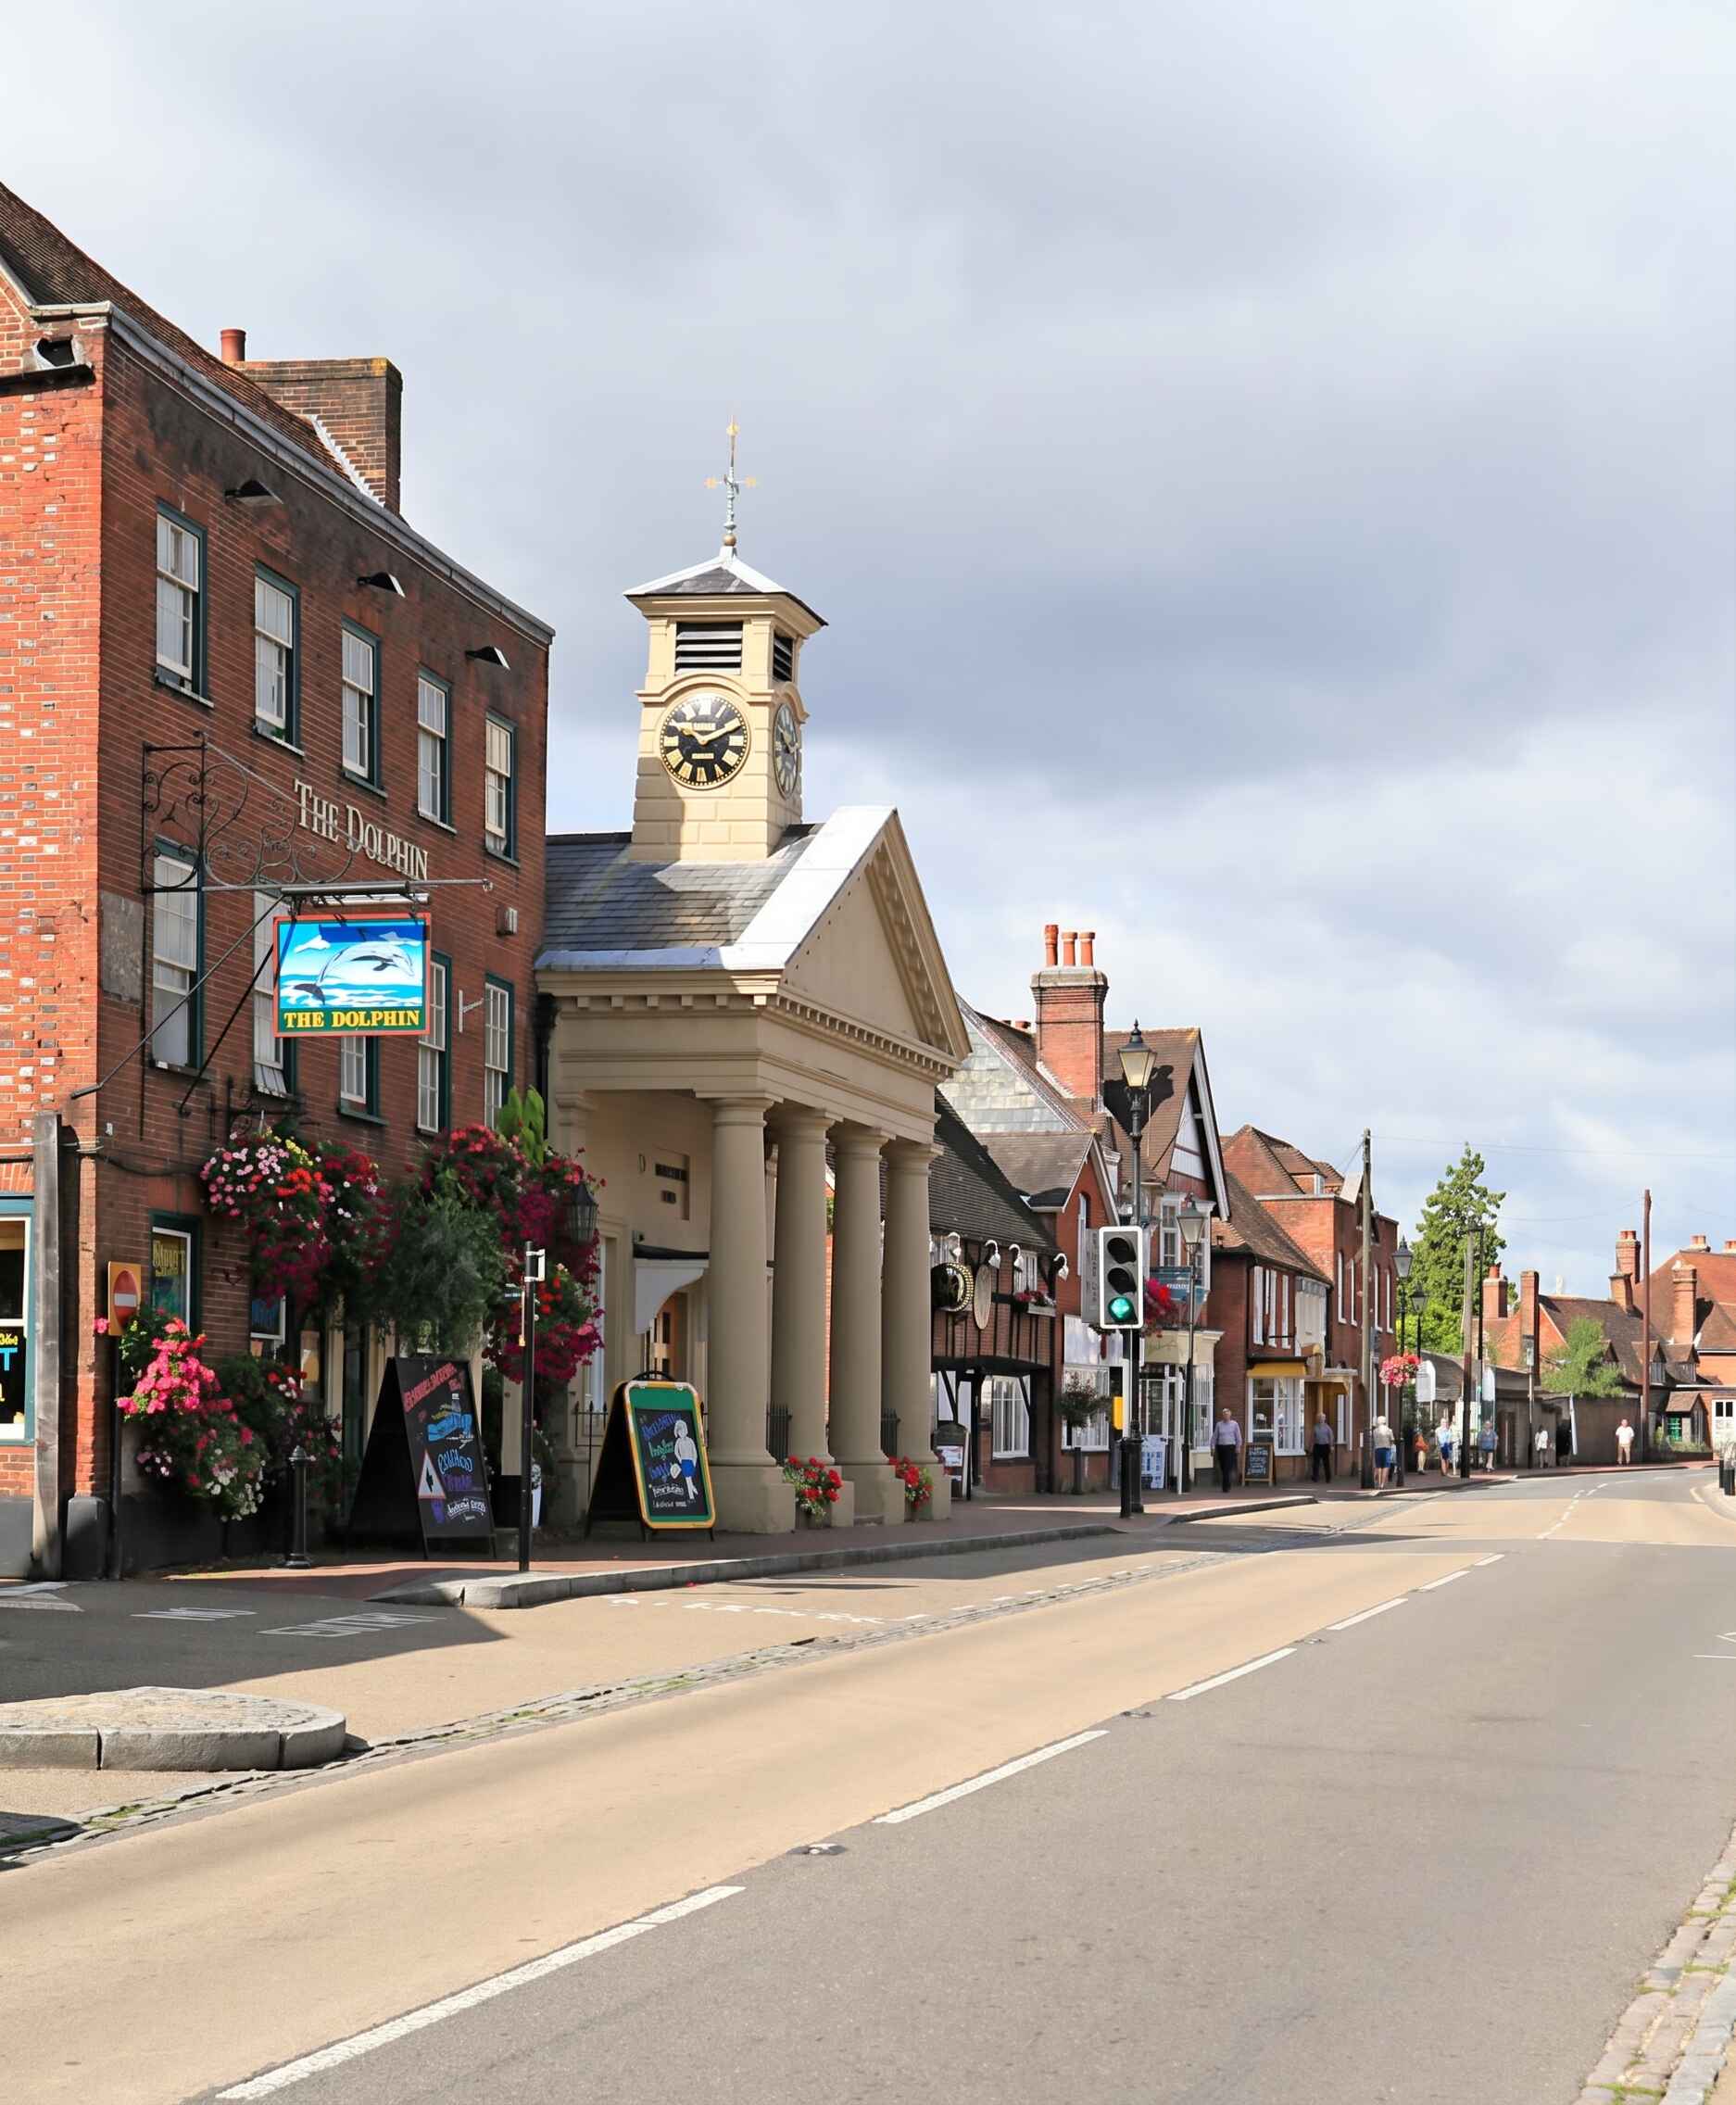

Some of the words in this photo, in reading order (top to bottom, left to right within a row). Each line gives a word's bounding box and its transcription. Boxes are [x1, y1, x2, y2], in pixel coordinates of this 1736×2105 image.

[294, 778, 339, 843] THE
[283, 1012, 324, 1028] THE
[332, 1009, 420, 1027] DOLPHIN
